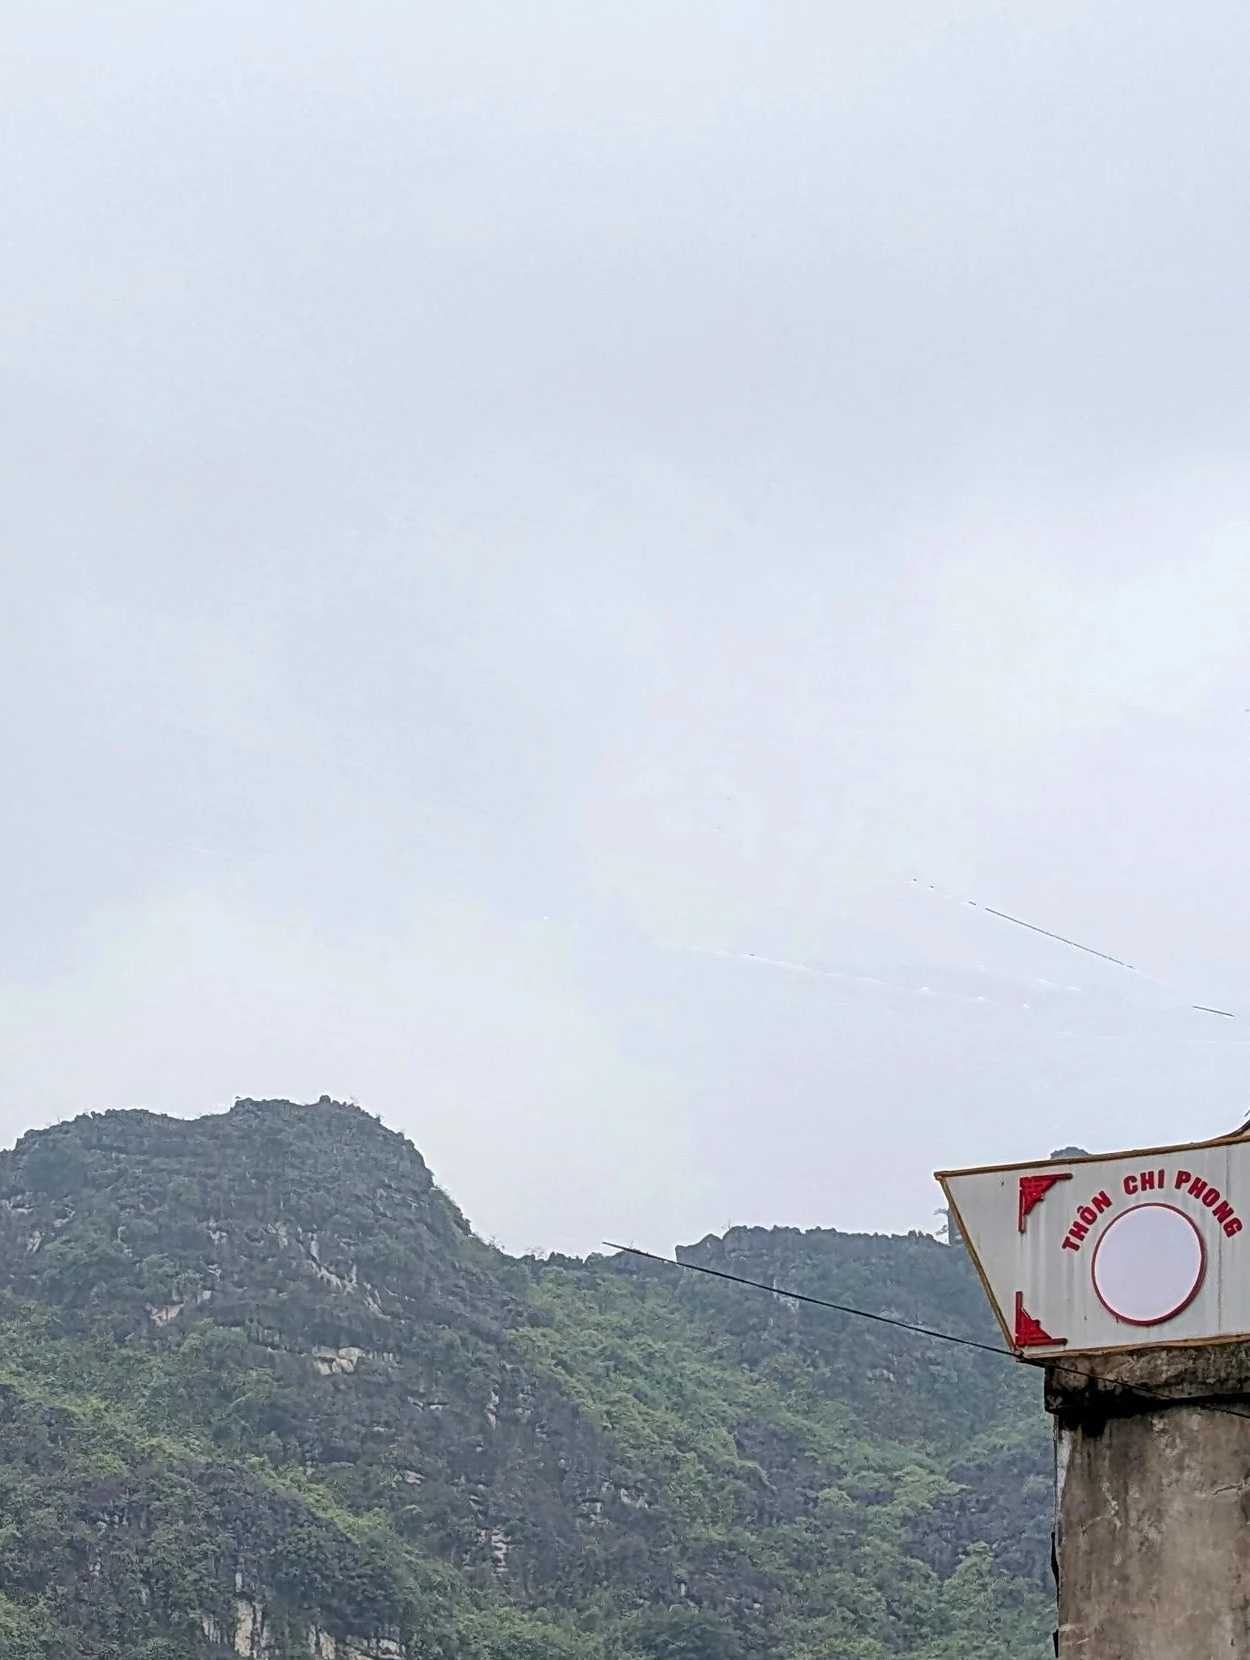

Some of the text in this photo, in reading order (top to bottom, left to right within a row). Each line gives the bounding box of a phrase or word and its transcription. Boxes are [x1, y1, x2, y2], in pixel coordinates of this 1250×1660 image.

[1061, 1169, 1243, 1252] THÔN CHI PHONG
